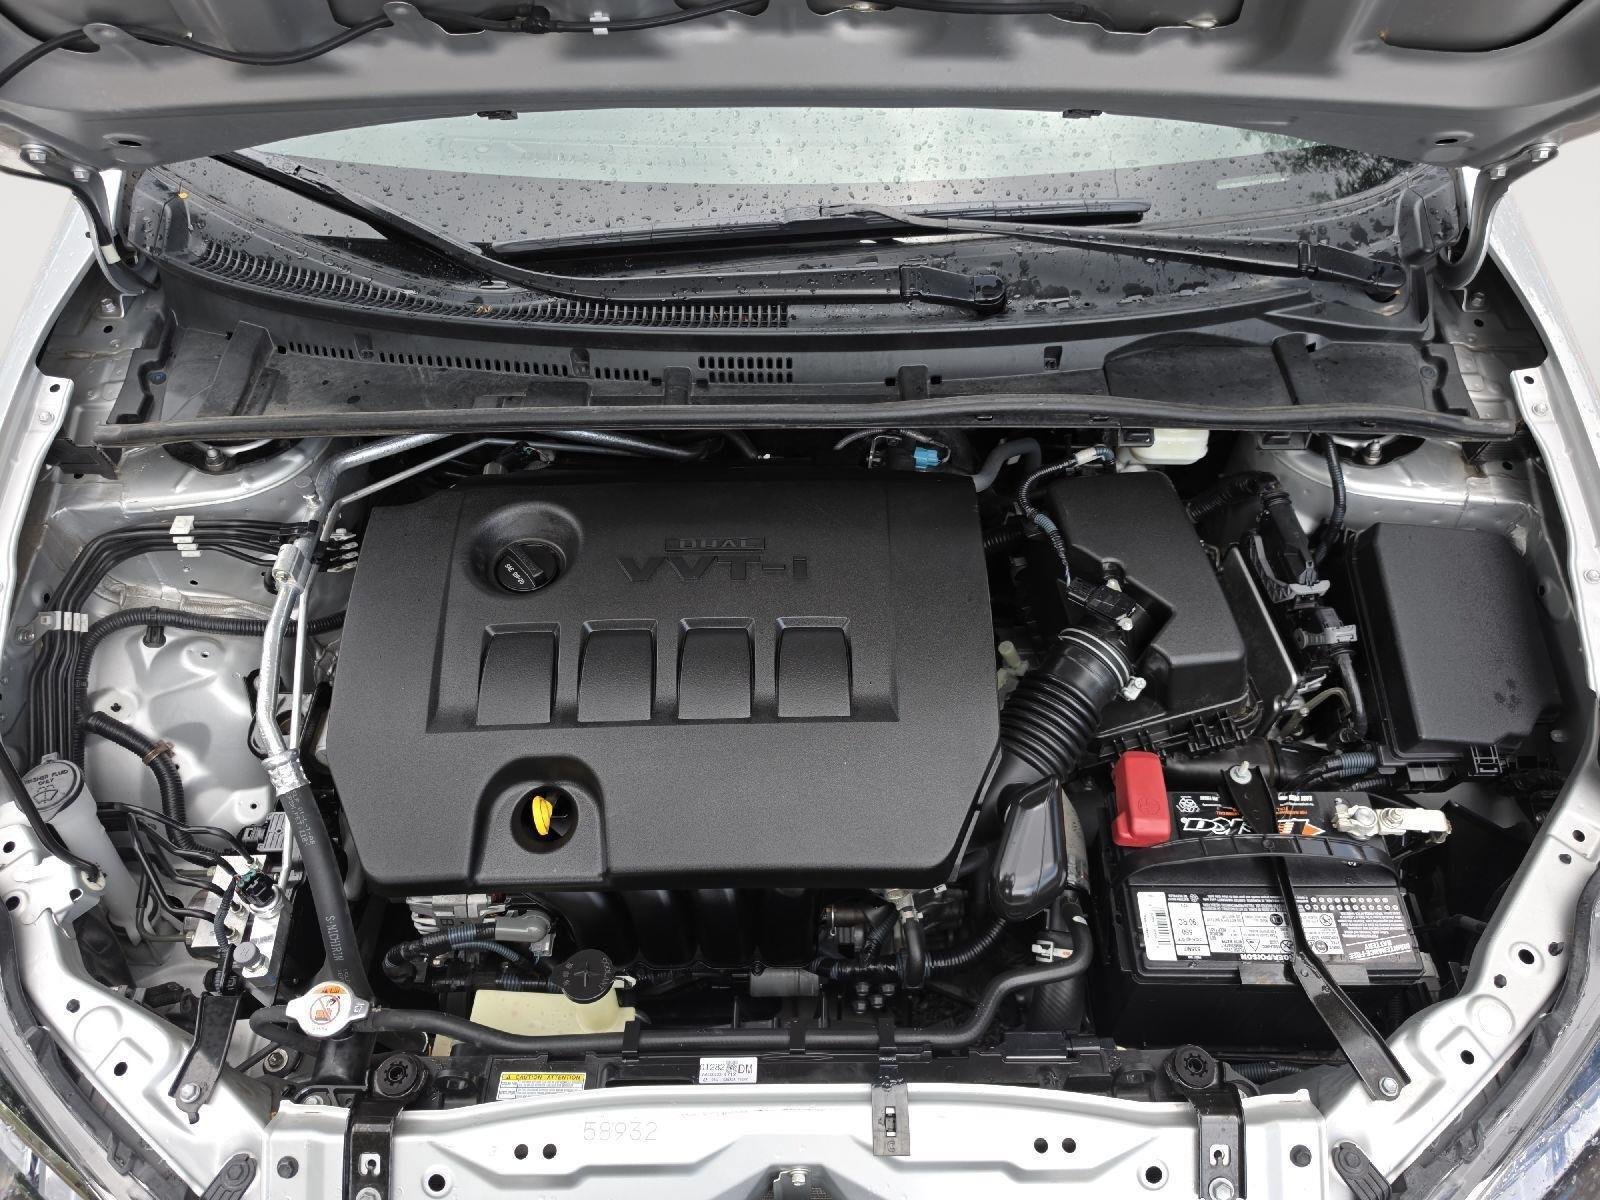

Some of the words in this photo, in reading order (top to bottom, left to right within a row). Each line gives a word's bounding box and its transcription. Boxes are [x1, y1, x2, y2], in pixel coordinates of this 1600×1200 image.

[679, 538, 755, 549] DUAL
[51, 769, 69, 777] FLUID
[37, 777, 55, 786] ONLY
[1364, 939, 1393, 951] BATTERY
[1348, 942, 1411, 960] MAINTENANCE-FREE
